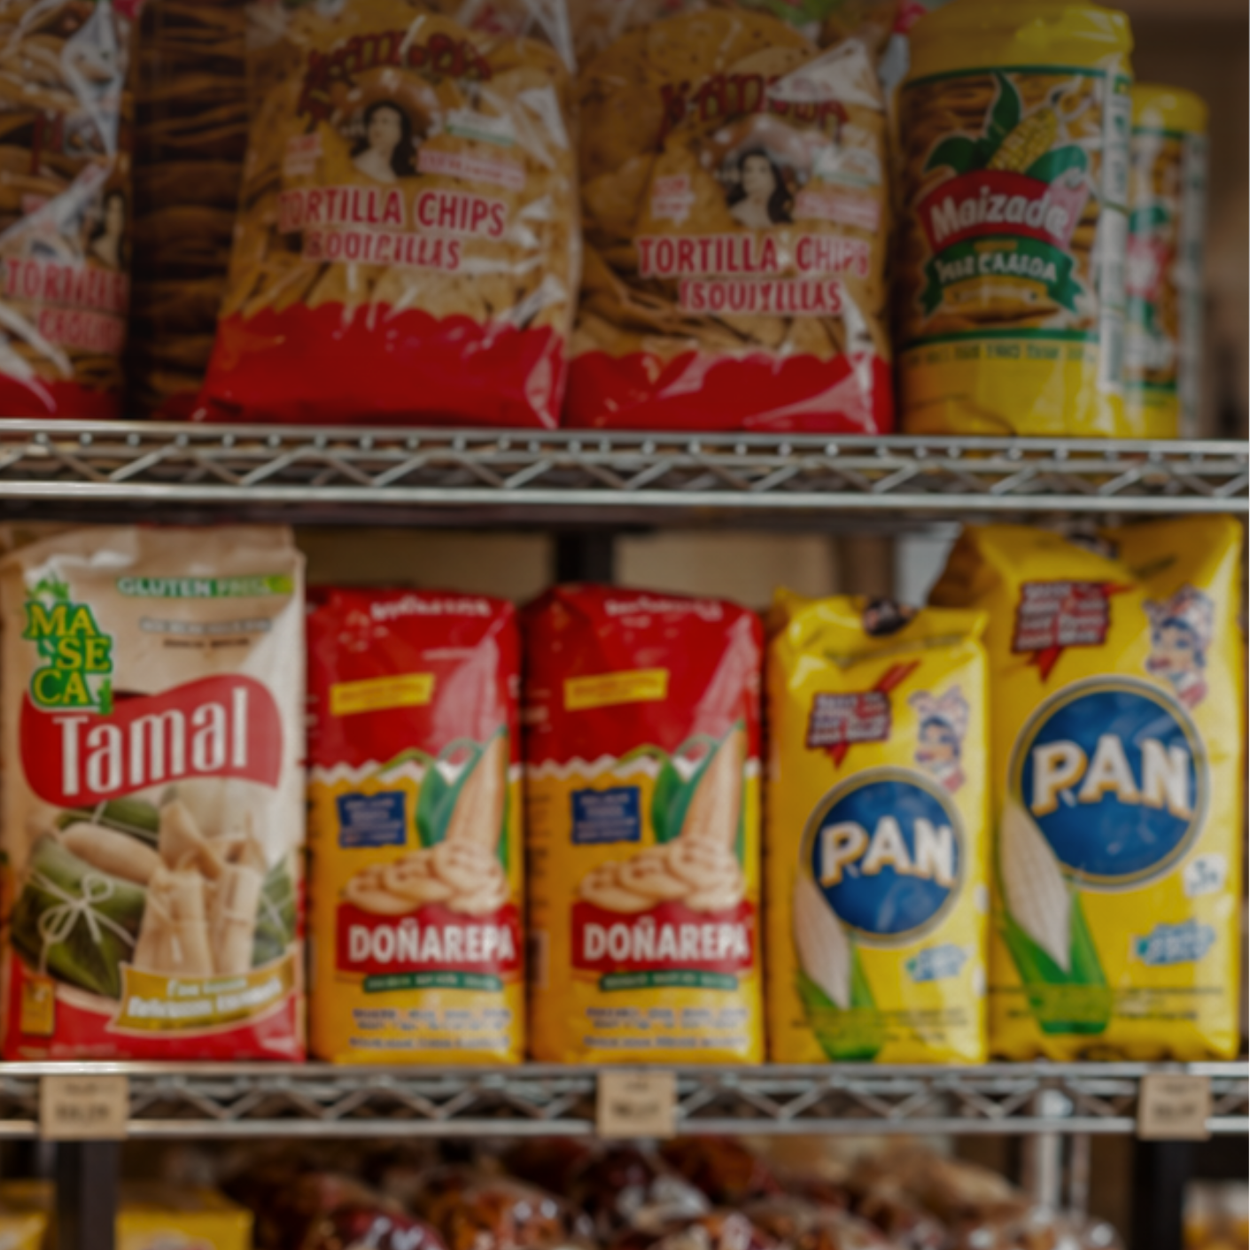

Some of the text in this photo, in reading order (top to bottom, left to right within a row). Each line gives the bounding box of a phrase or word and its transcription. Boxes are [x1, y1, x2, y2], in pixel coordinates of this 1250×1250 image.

[280, 187, 506, 237] TORTILLA CHIPS
[639, 236, 777, 275] TORTILLA
[117, 575, 212, 598] GLUTEN
[29, 604, 96, 637] MA
[55, 636, 110, 672] SE
[32, 670, 89, 706] CA
[51, 687, 249, 797] Tamal
[347, 916, 518, 964] DOÑAREPA
[581, 915, 751, 962] DOÑAREPA
